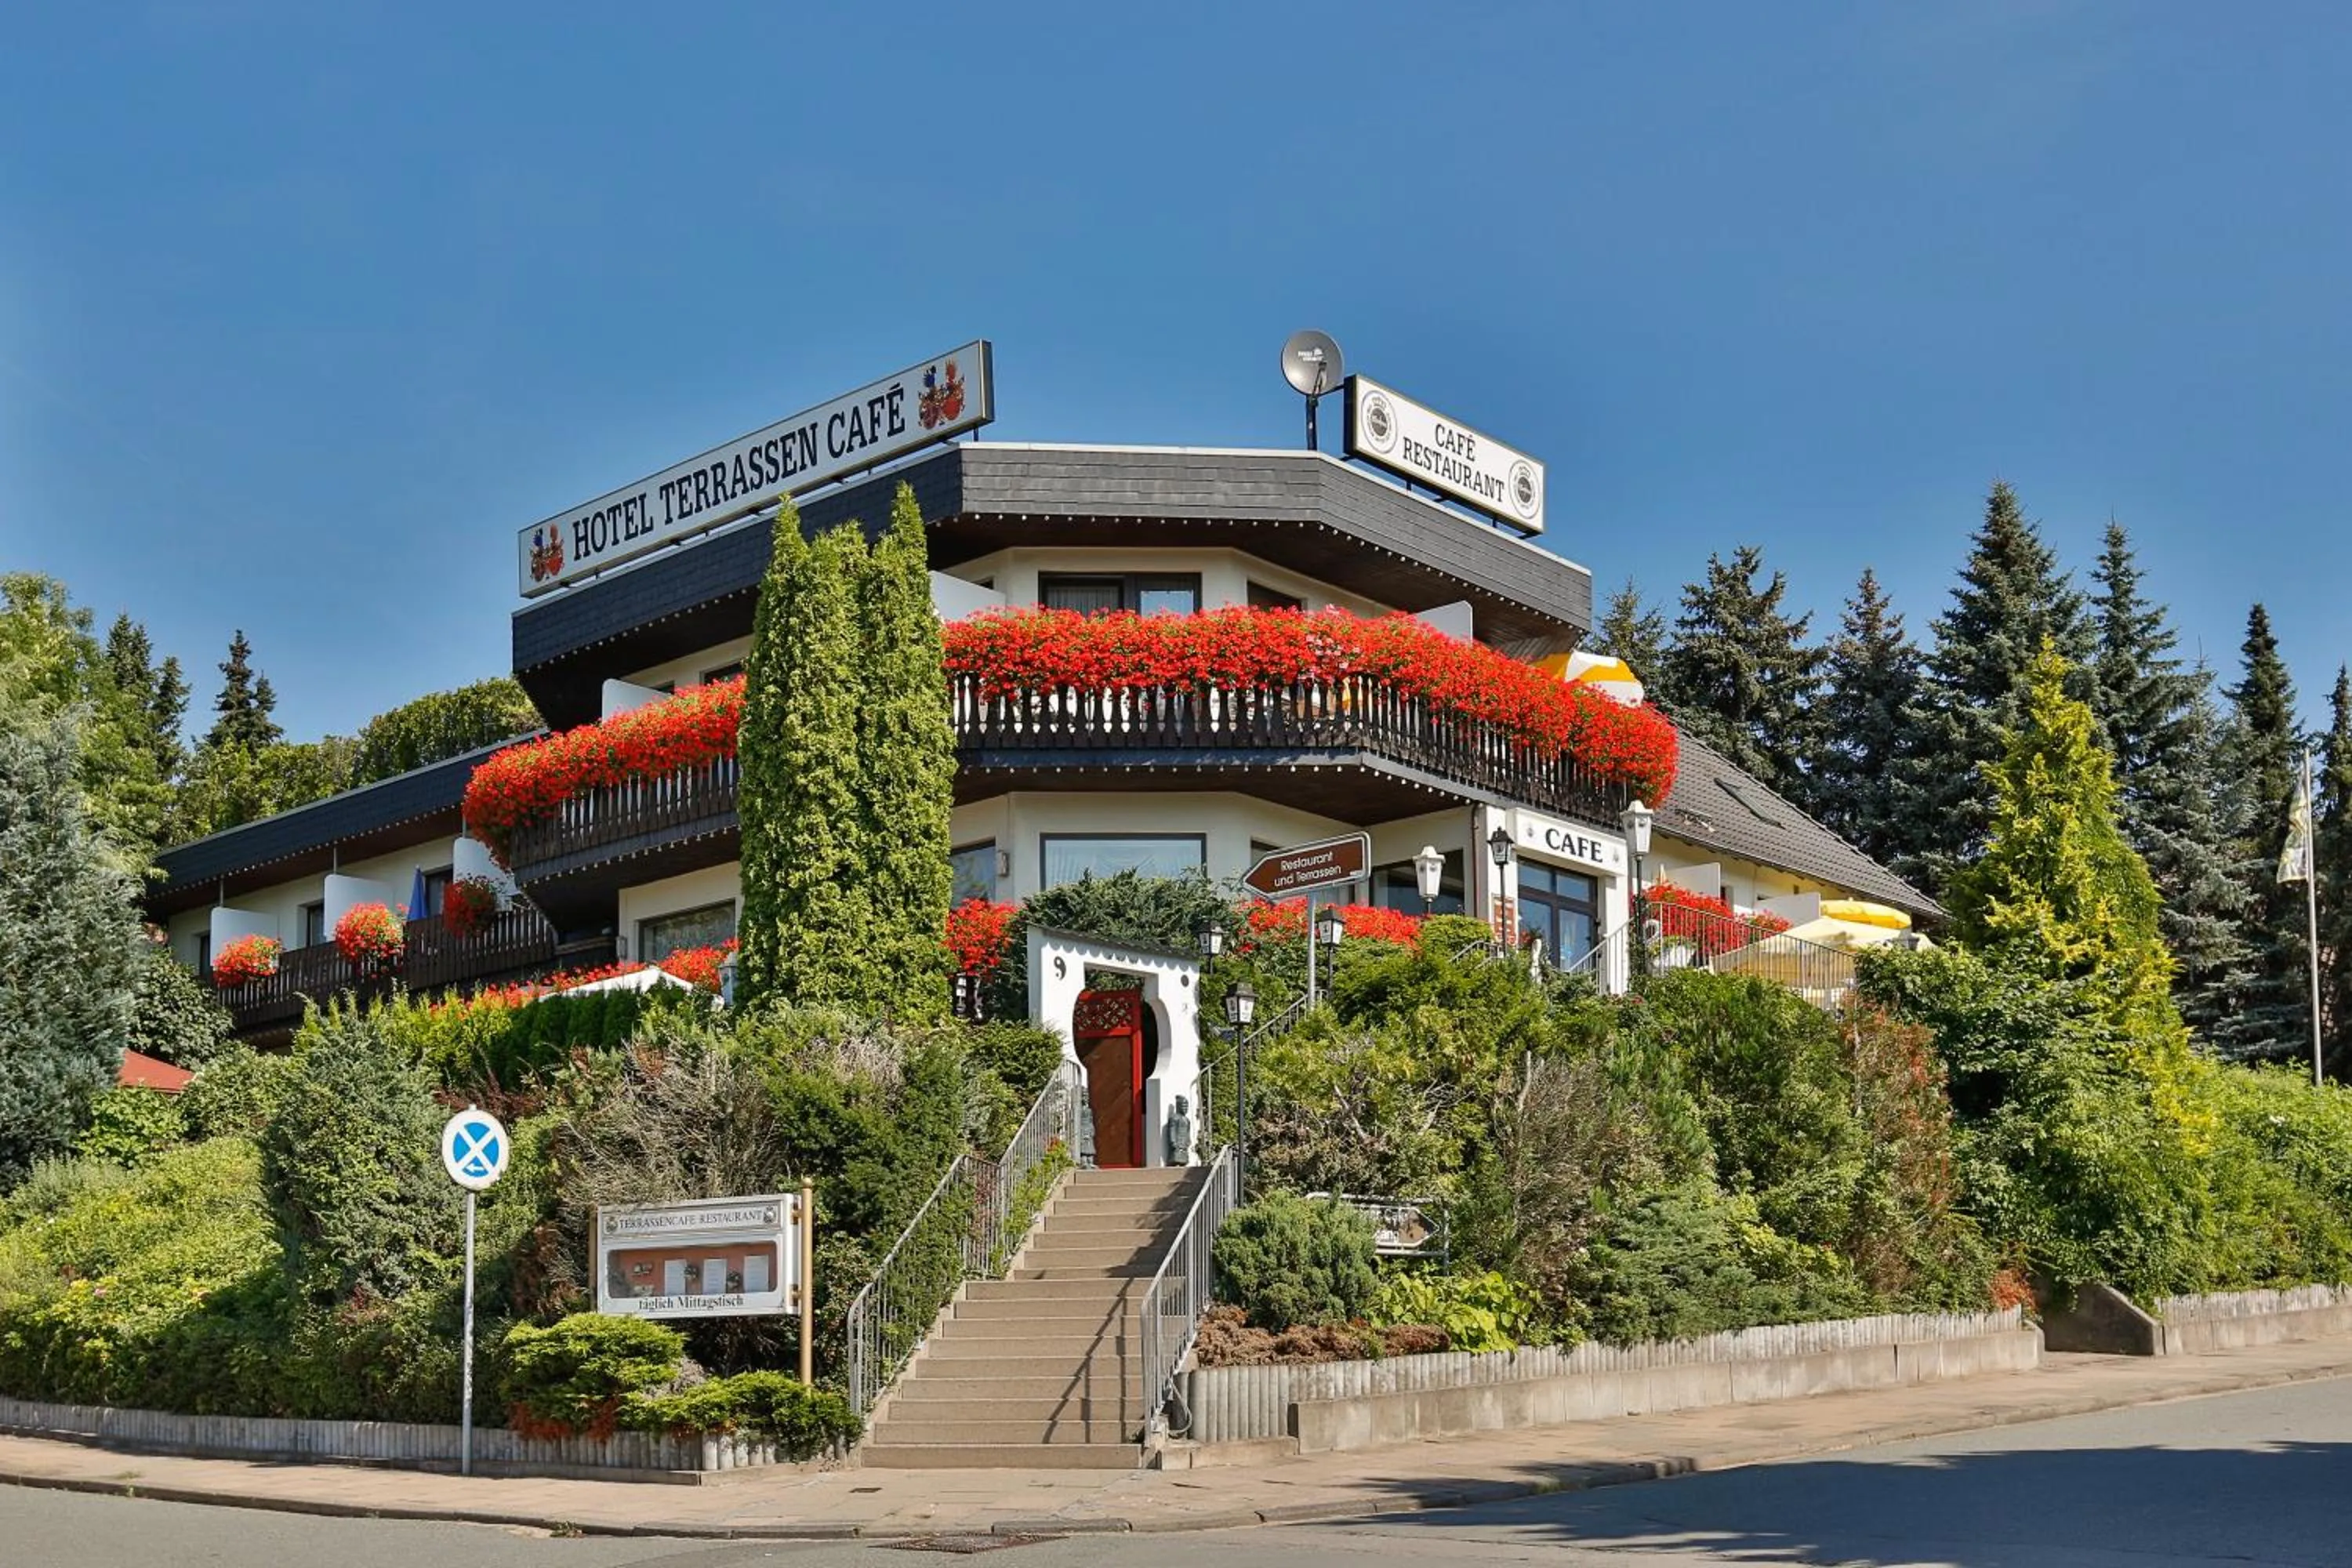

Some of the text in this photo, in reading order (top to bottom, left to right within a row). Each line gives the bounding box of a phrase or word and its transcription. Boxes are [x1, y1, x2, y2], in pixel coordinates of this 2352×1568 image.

[1435, 423, 1475, 462] CAFÉ
[572, 382, 906, 561] HOTEL TERRASSEN CAFÉ
[1403, 436, 1504, 502] RESTAURANT
[1544, 827, 1603, 863] CAFE
[1274, 874, 1294, 887] und
[1296, 864, 1342, 883] Terrassen
[1280, 851, 1334, 871] Restaurant
[699, 1209, 762, 1225] RESTAURANT
[639, 1294, 744, 1312] täglich Mittagstisch
